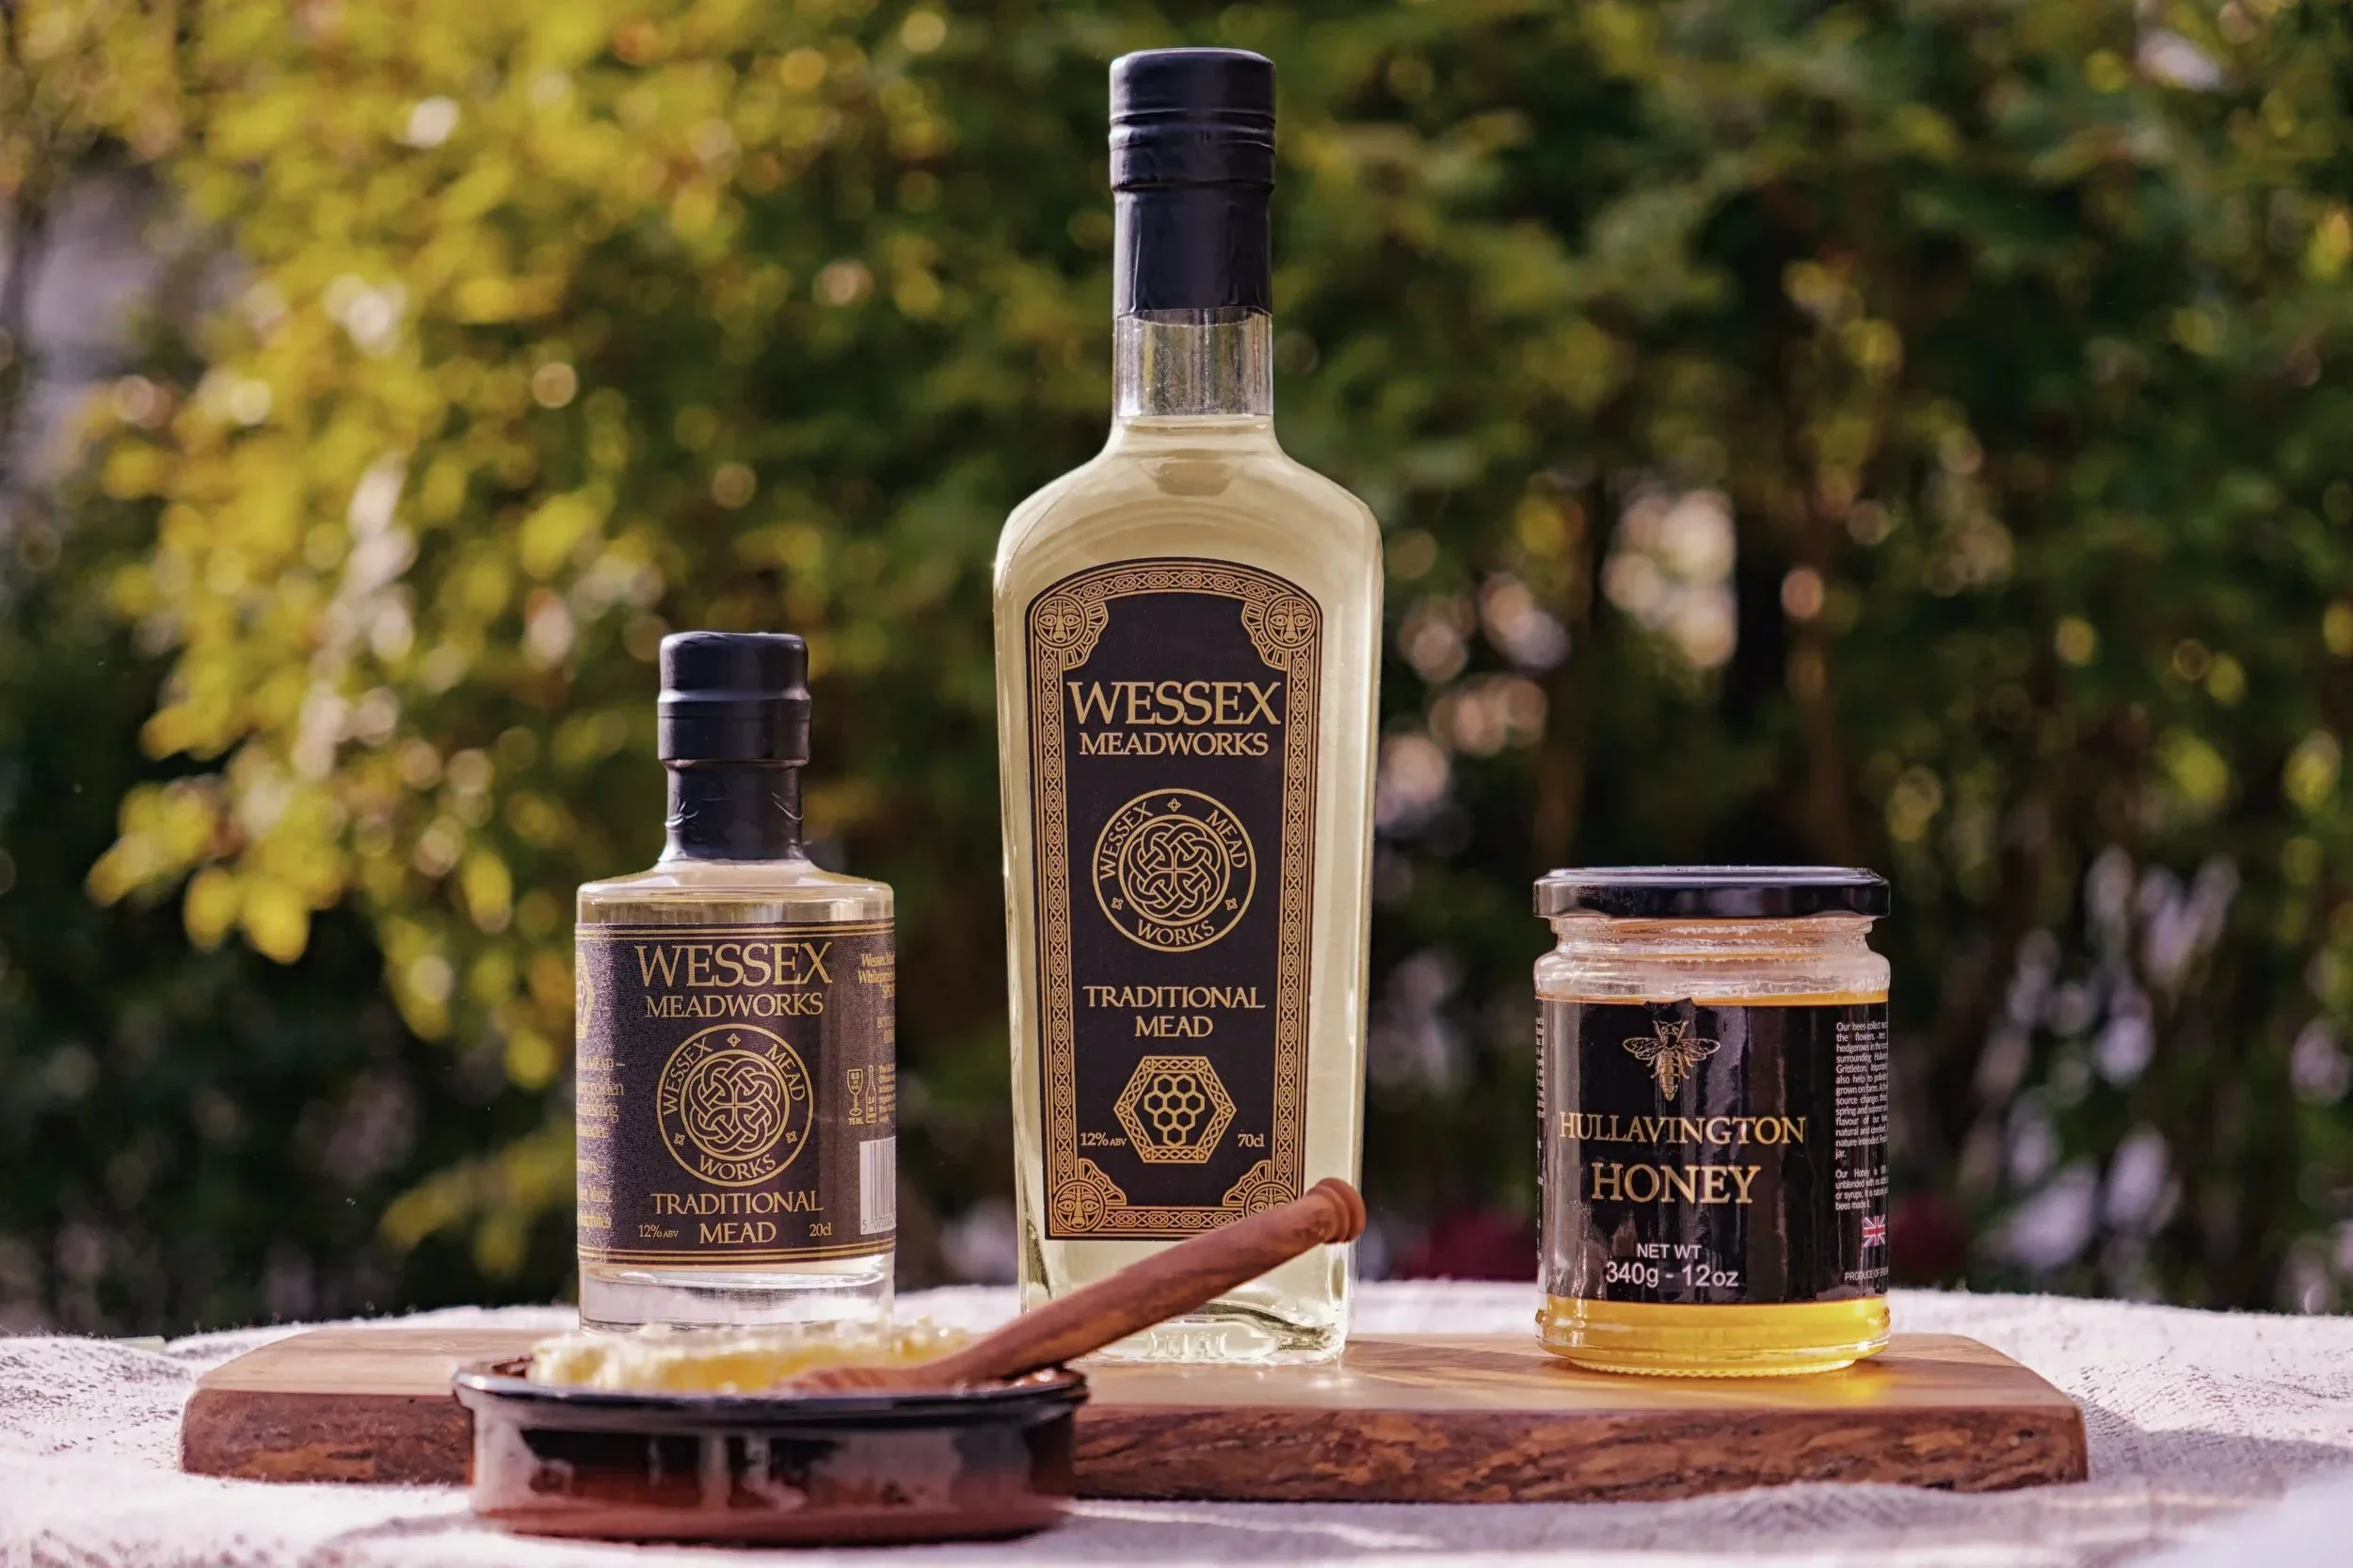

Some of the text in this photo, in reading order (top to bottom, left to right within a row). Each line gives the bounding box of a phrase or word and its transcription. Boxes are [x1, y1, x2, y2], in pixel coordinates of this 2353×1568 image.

[1066, 680, 1281, 725] WESSEX
[1080, 732, 1269, 756] MEADWORKS
[1099, 801, 1248, 881] WESSEX MEAD
[1137, 919, 1214, 946] WORKS
[634, 942, 833, 987] WESSEX
[1082, 985, 1266, 1008] TRADITIONAL
[646, 992, 824, 1017] MEADWORKS
[1135, 1016, 1213, 1037] MEAD
[1836, 1022, 1850, 1032] Our
[1852, 1022, 1865, 1031] bees
[1836, 1033, 1849, 1042] the
[1836, 1044, 1869, 1053] hedgerows
[1836, 1053, 1872, 1064] surrounding
[663, 1037, 713, 1115] WESSEX
[764, 1043, 806, 1101] MEAD
[1836, 1075, 1849, 1084] also
[1852, 1074, 1865, 1084] help
[1866, 1074, 1873, 1082] to
[1836, 1086, 1857, 1096] grown
[1836, 1097, 1858, 1106] source
[1836, 1106, 1857, 1117] spring
[1857, 1105, 1868, 1114] and
[1560, 1112, 1806, 1144] HULLAVINGTON
[1836, 1117, 1859, 1127] flavour
[1863, 1115, 1869, 1125] of
[1836, 1127, 1859, 1137] natural
[1860, 1126, 1869, 1135] and
[1238, 1133, 1265, 1147] 70cl
[1836, 1139, 1858, 1147] nature
[698, 1154, 776, 1180] WORKS
[1835, 1169, 1848, 1178] Our
[1854, 1168, 1870, 1178] Honey
[1592, 1162, 1761, 1204] HONEY
[1835, 1180, 1865, 1190] unblended
[650, 1190, 824, 1214] TRADITIONAL
[1835, 1202, 1851, 1210] bees
[1851, 1201, 1866, 1209] made
[699, 1222, 776, 1244] MEAD
[809, 1223, 832, 1237] 20cl
[1637, 1243, 1702, 1259] NET WT
[1606, 1262, 1658, 1288] 340g
[1682, 1265, 1739, 1287] 12oz
[1845, 1271, 1873, 1281] PRODUCE
